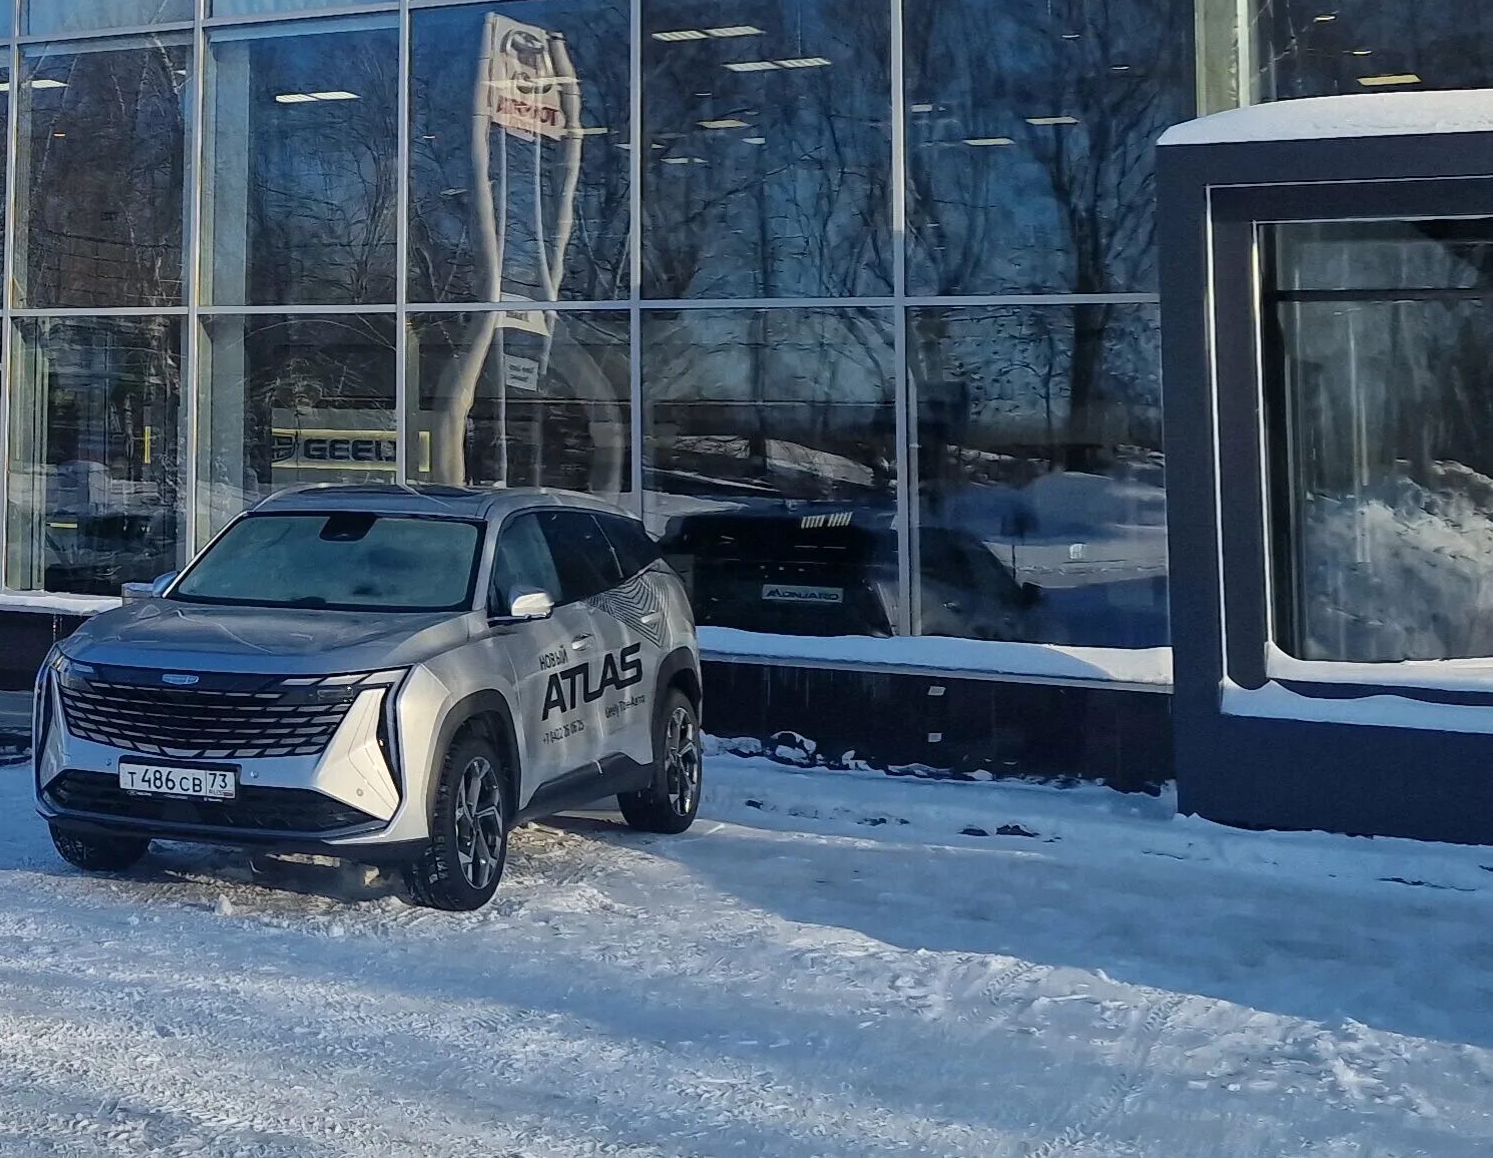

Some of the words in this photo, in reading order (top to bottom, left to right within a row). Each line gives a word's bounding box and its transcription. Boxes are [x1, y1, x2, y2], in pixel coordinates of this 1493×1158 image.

[303, 438, 397, 462] GEEL
[541, 642, 643, 722] ATLAS
[208, 772, 228, 790] 73
